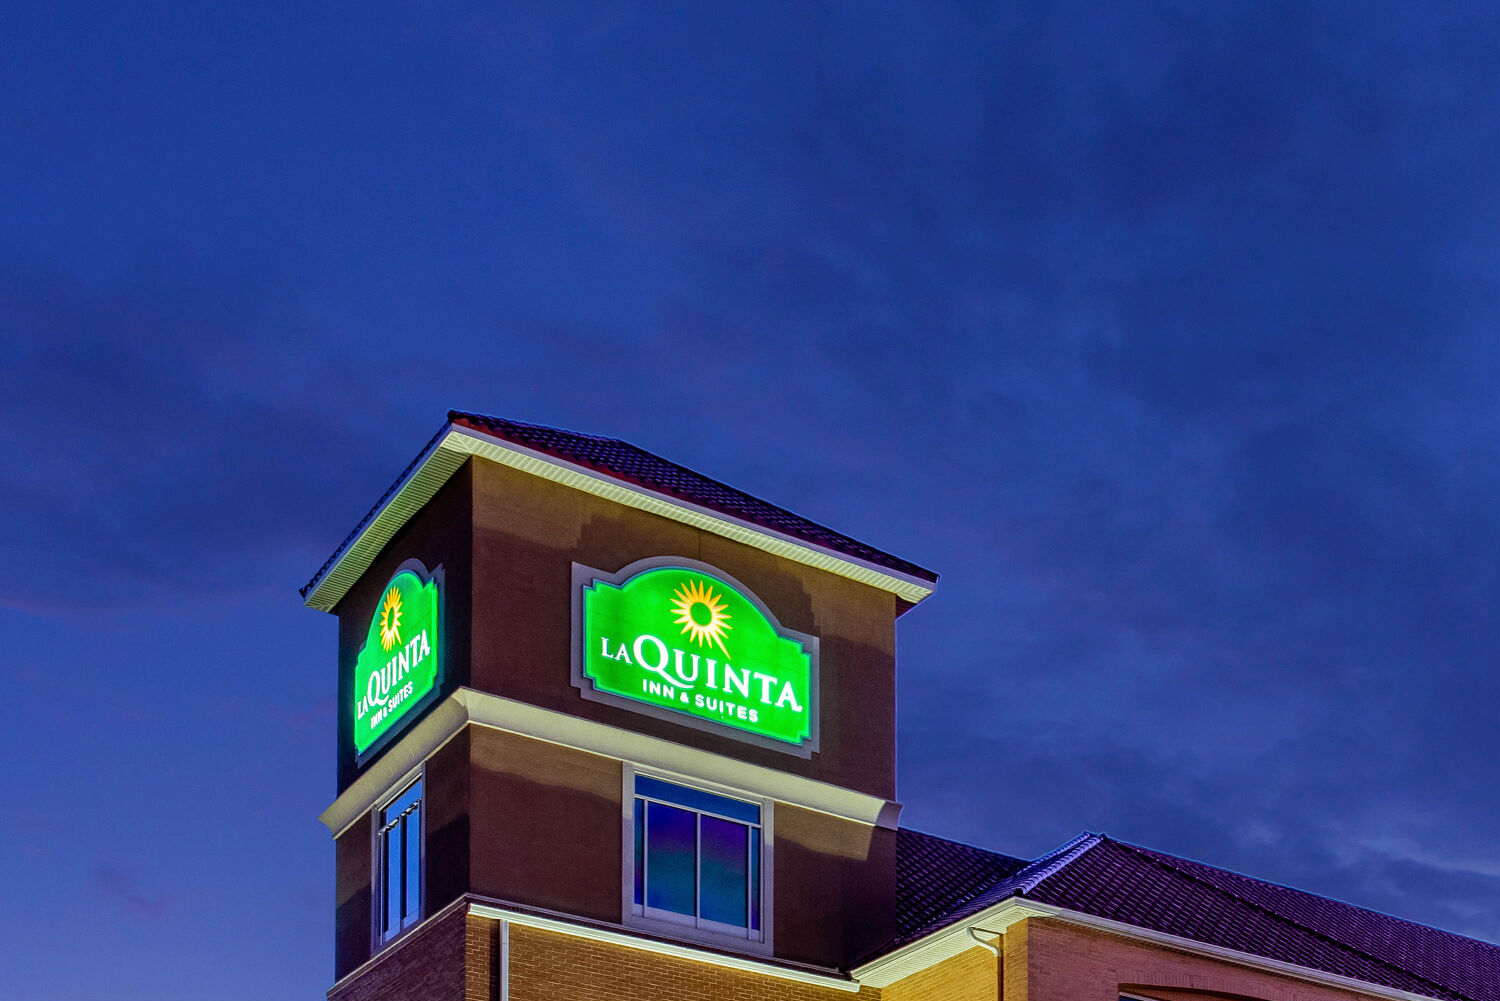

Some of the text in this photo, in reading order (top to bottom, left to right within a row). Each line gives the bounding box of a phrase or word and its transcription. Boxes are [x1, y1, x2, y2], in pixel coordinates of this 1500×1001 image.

[357, 629, 431, 720] LA QUINTA
[370, 709, 382, 730] INN
[388, 681, 413, 713] SUITES
[601, 634, 803, 713] LA QUINTA
[642, 678, 759, 723] INN & SUITES
